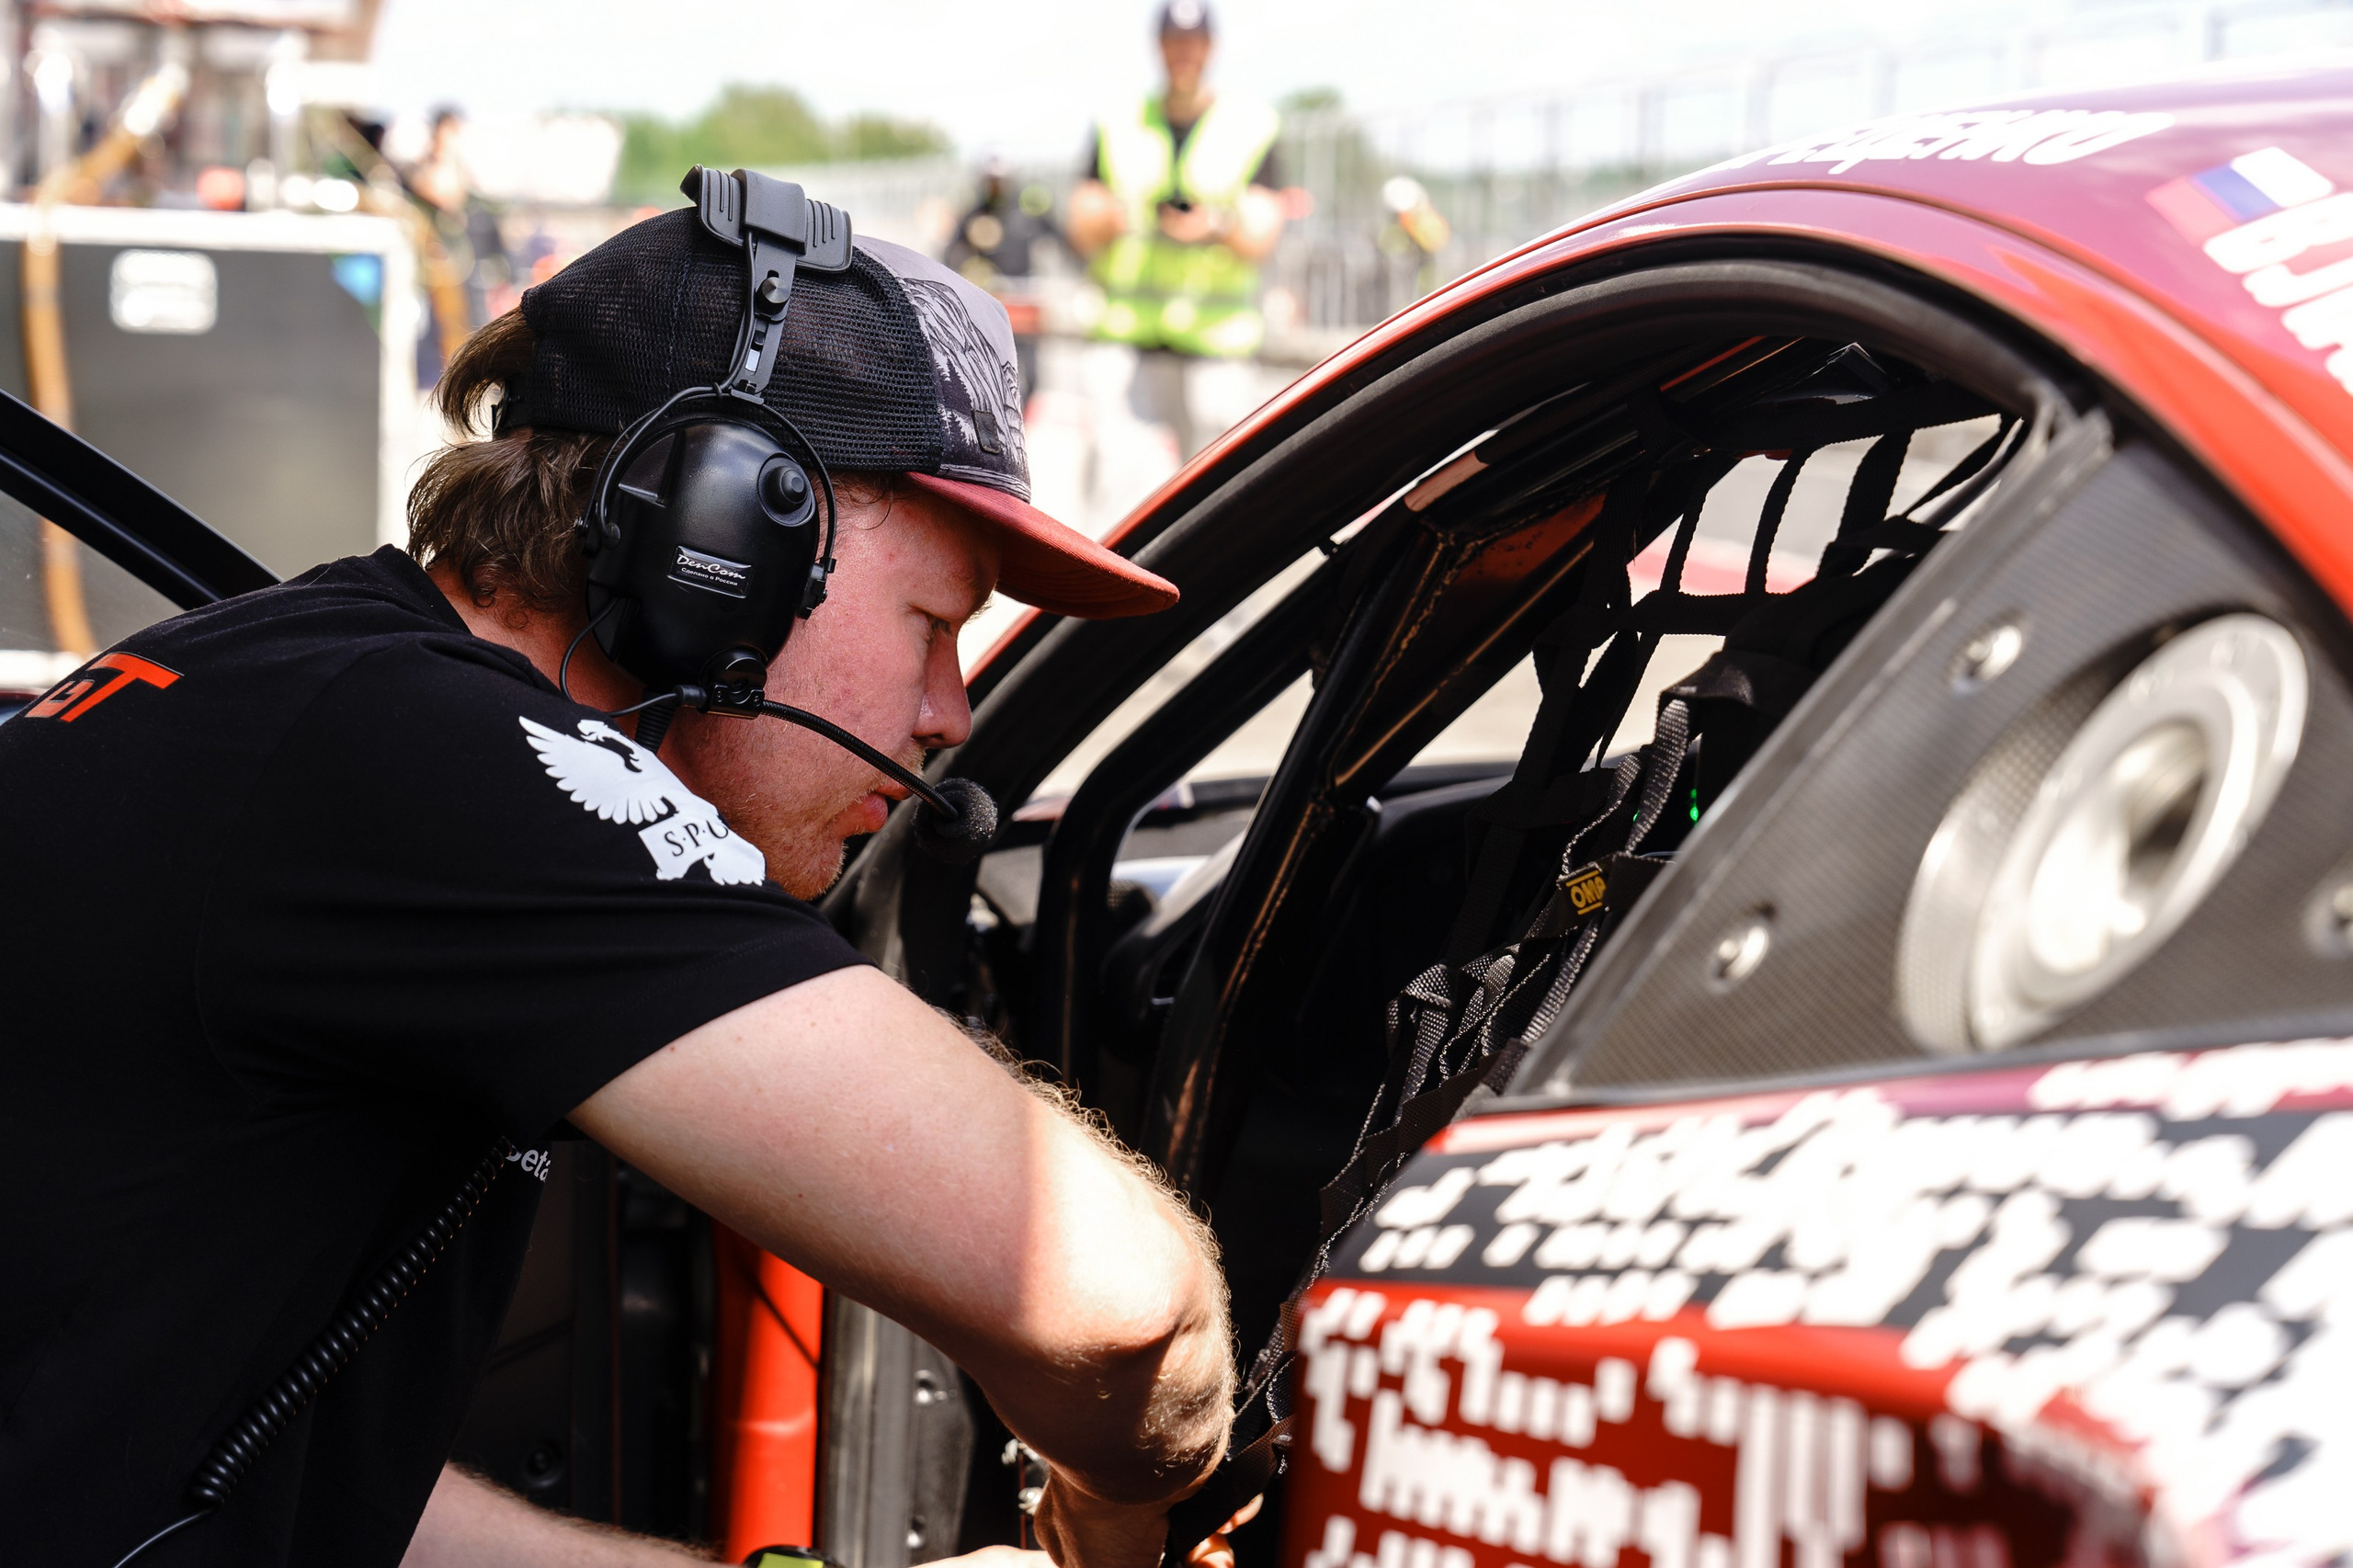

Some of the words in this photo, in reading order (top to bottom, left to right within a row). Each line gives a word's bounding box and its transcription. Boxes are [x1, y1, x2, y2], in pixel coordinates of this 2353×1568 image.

[676, 553, 746, 580] DenCom
[681, 567, 709, 579] Сделано
[715, 576, 738, 586] России
[1570, 876, 1607, 908] OMP
